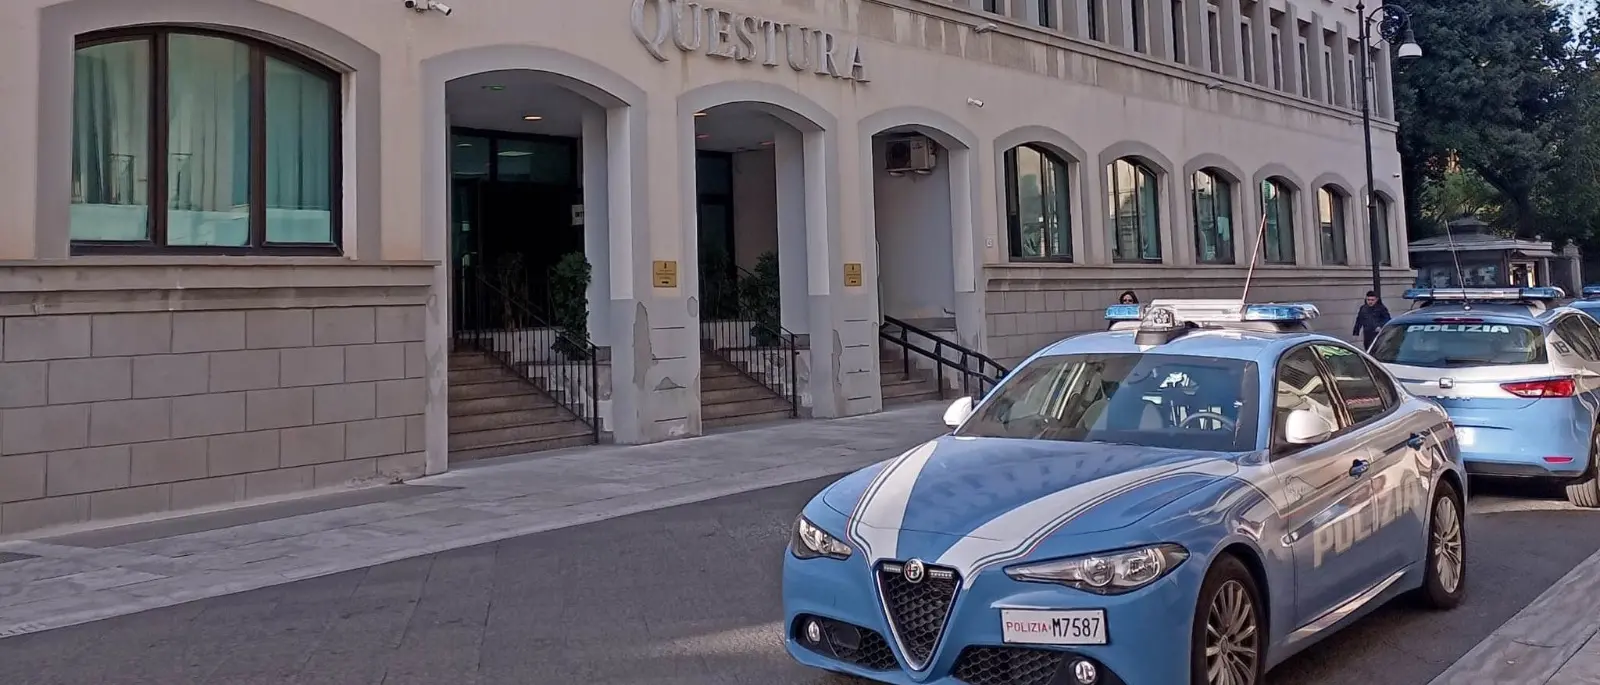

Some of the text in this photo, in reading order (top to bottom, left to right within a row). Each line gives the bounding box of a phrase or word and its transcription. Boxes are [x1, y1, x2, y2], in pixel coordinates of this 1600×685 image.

[630, 0, 870, 83] QUESTURA
[1407, 324, 1510, 334] POLIZIA
[1006, 617, 1100, 638] POLIZIA M7587
